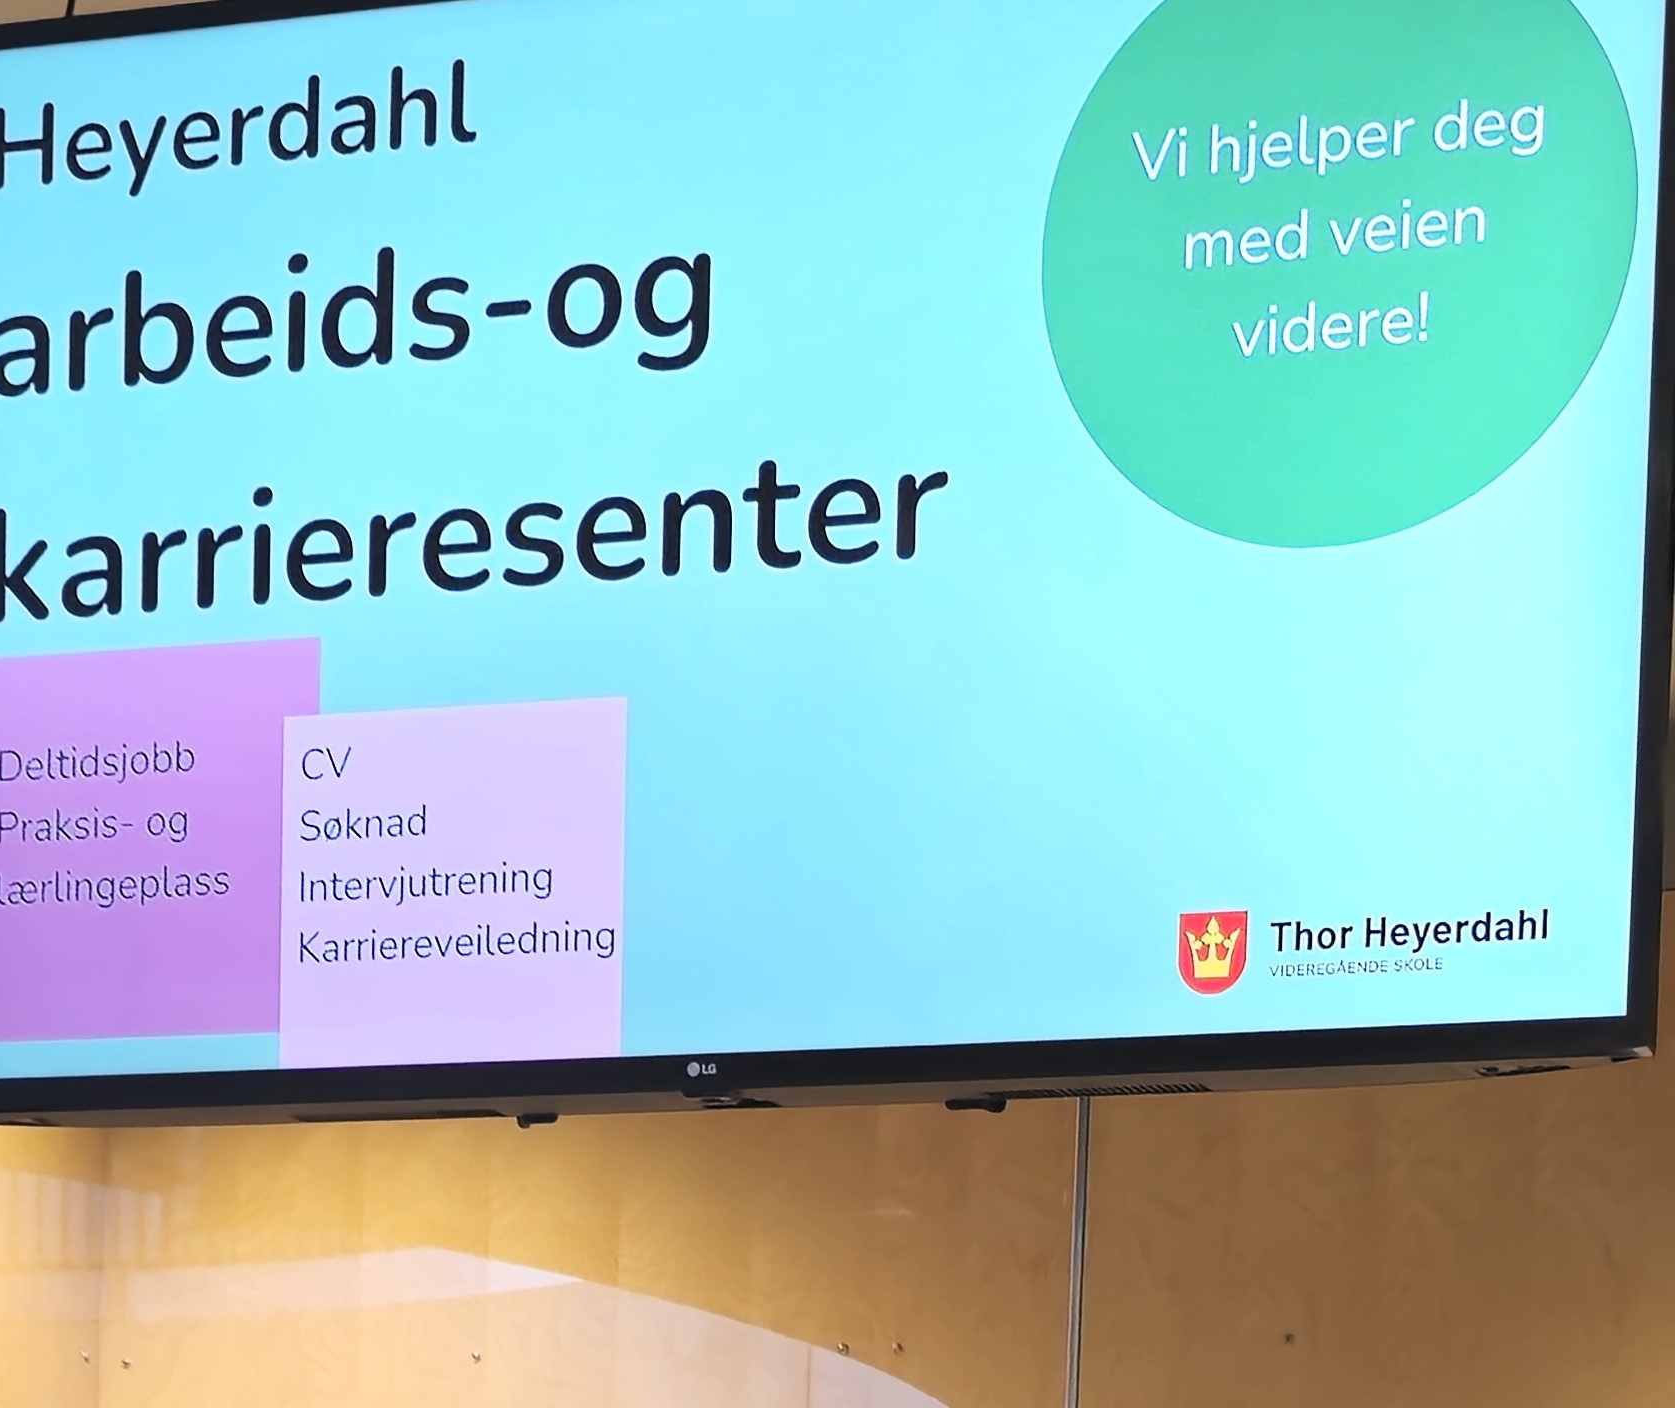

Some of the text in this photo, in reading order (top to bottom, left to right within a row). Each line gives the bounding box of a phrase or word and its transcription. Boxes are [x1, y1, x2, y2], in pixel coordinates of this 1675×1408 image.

[1130, 98, 1545, 184] Vi hjelper deg
[1183, 198, 1486, 270] med veien
[1230, 290, 1429, 359] videre!
[301, 746, 352, 780] CV
[147, 811, 188, 843] og
[300, 804, 426, 842] Søknad
[300, 861, 552, 907] Intervjutrening
[299, 920, 615, 963] Karriereveiledning
[1270, 908, 1549, 954] Thor Heyerdahl
[1269, 957, 1443, 977] VIDEREGÅENDE SKOLE
[701, 1063, 717, 1075] LG
